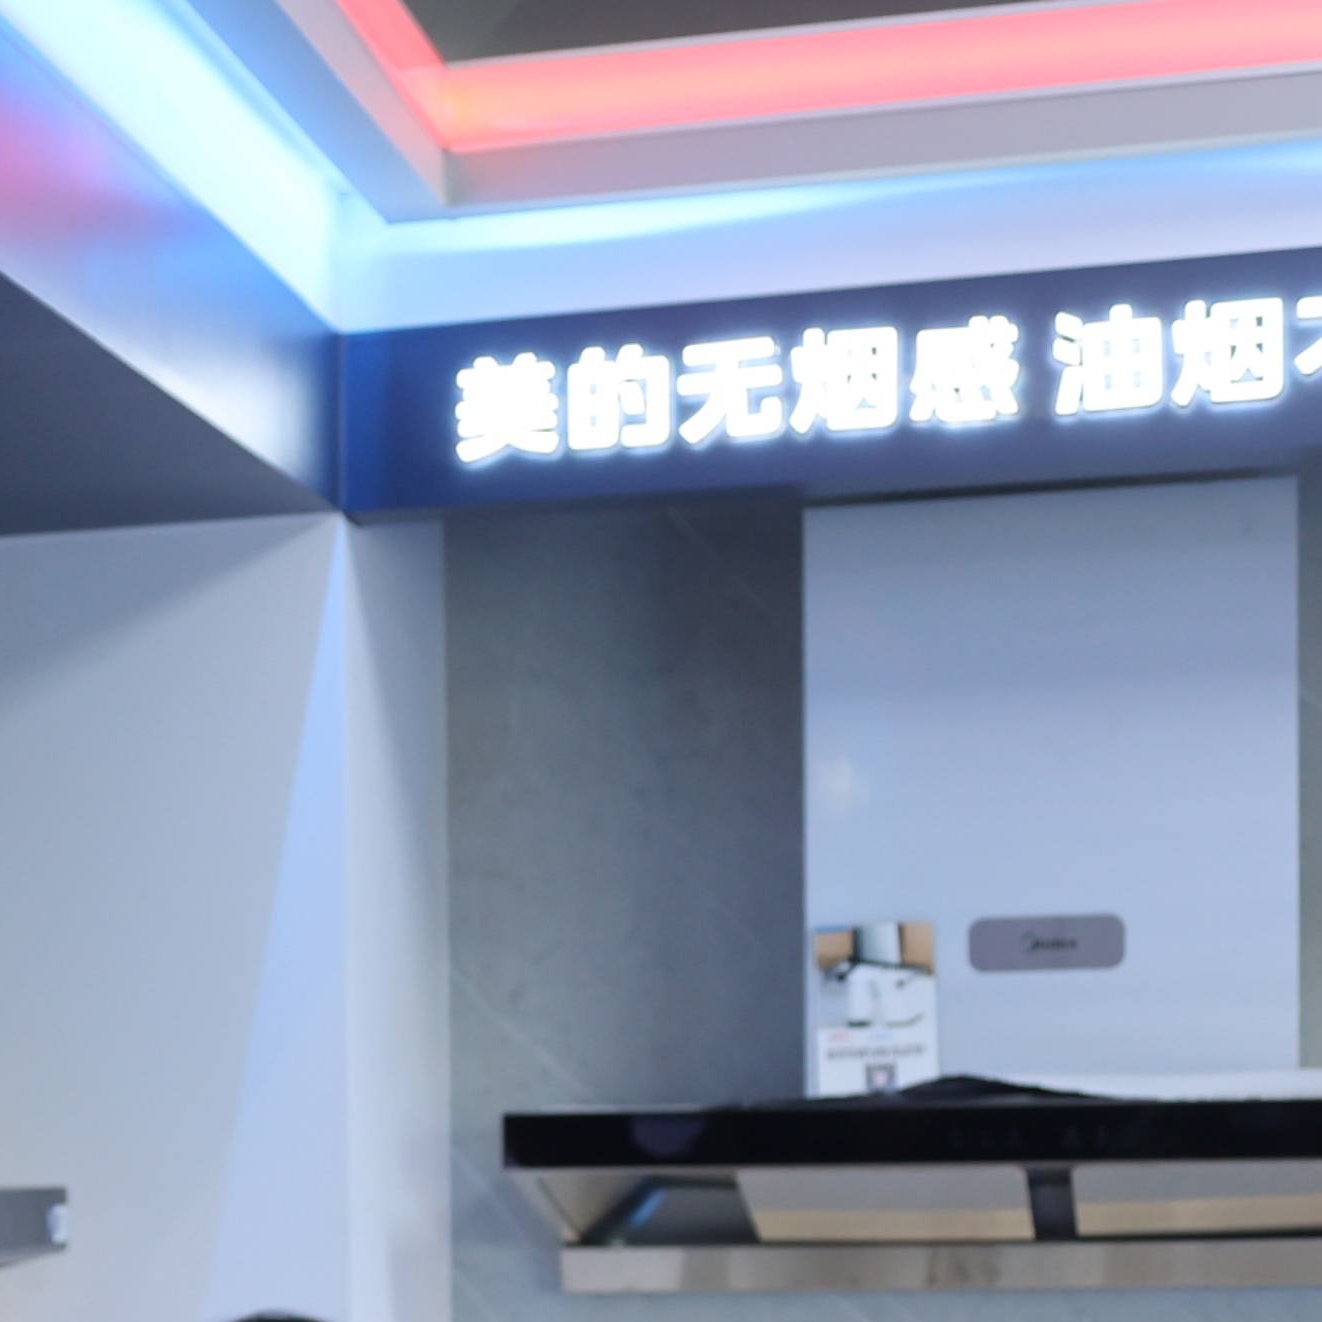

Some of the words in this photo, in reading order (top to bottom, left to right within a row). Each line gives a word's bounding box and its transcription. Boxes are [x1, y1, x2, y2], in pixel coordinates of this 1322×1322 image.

[454, 314, 1021, 465] 美的无烟感
